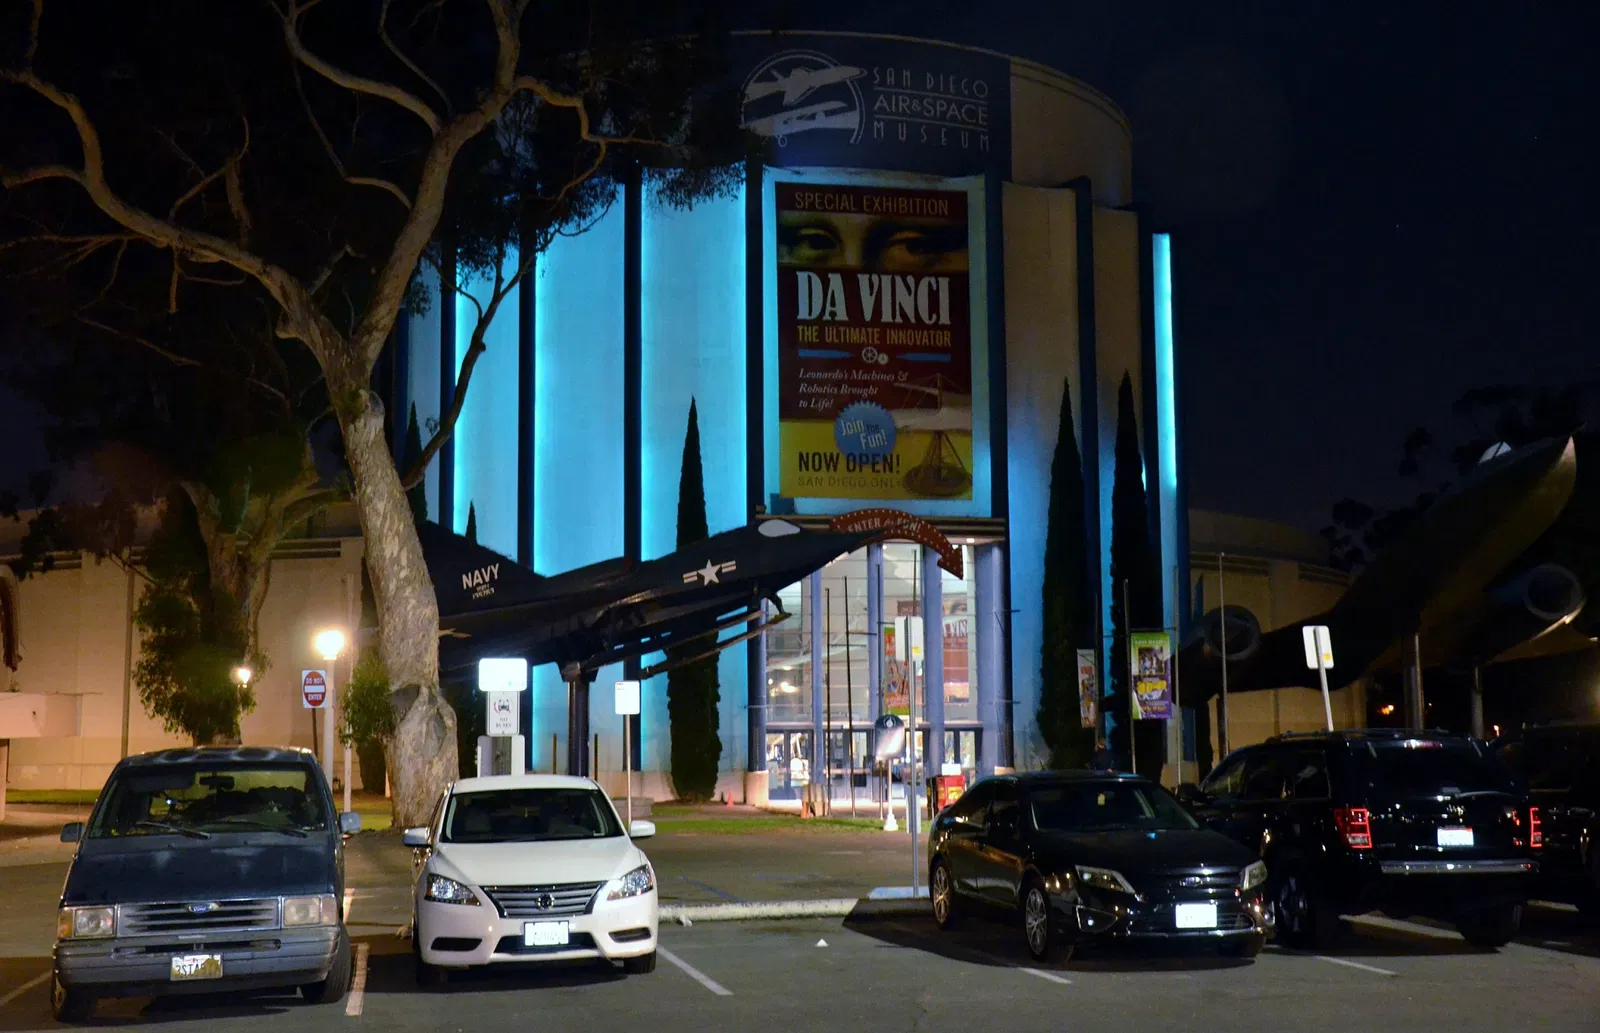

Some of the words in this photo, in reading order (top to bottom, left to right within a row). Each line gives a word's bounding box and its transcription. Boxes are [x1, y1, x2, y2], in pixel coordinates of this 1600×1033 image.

[873, 66, 910, 88] SAN
[926, 74, 989, 98] DIEGO
[874, 121, 990, 152] MUSEUM
[795, 192, 857, 211] SPECIAL
[863, 195, 949, 216] EXHIBITION
[795, 271, 849, 321] DA
[857, 273, 951, 325] VINCI
[797, 325, 820, 343] THE
[825, 326, 880, 345] ULTIMATE
[886, 328, 951, 347] INNOVATOR
[799, 368, 849, 380] Leonardo's
[850, 369, 895, 382] Machines
[798, 382, 838, 395] Robotics
[840, 384, 879, 398] Brought
[799, 398, 808, 408] to
[810, 397, 834, 411] Life!
[840, 418, 865, 436] Join
[860, 429, 888, 450] Fun!
[798, 451, 840, 472] NOW
[846, 453, 900, 474] OPEN!
[797, 475, 823, 487] SAN
[828, 475, 867, 488] DIEGO
[848, 518, 881, 533] ENTER
[462, 562, 499, 590] NAVY
